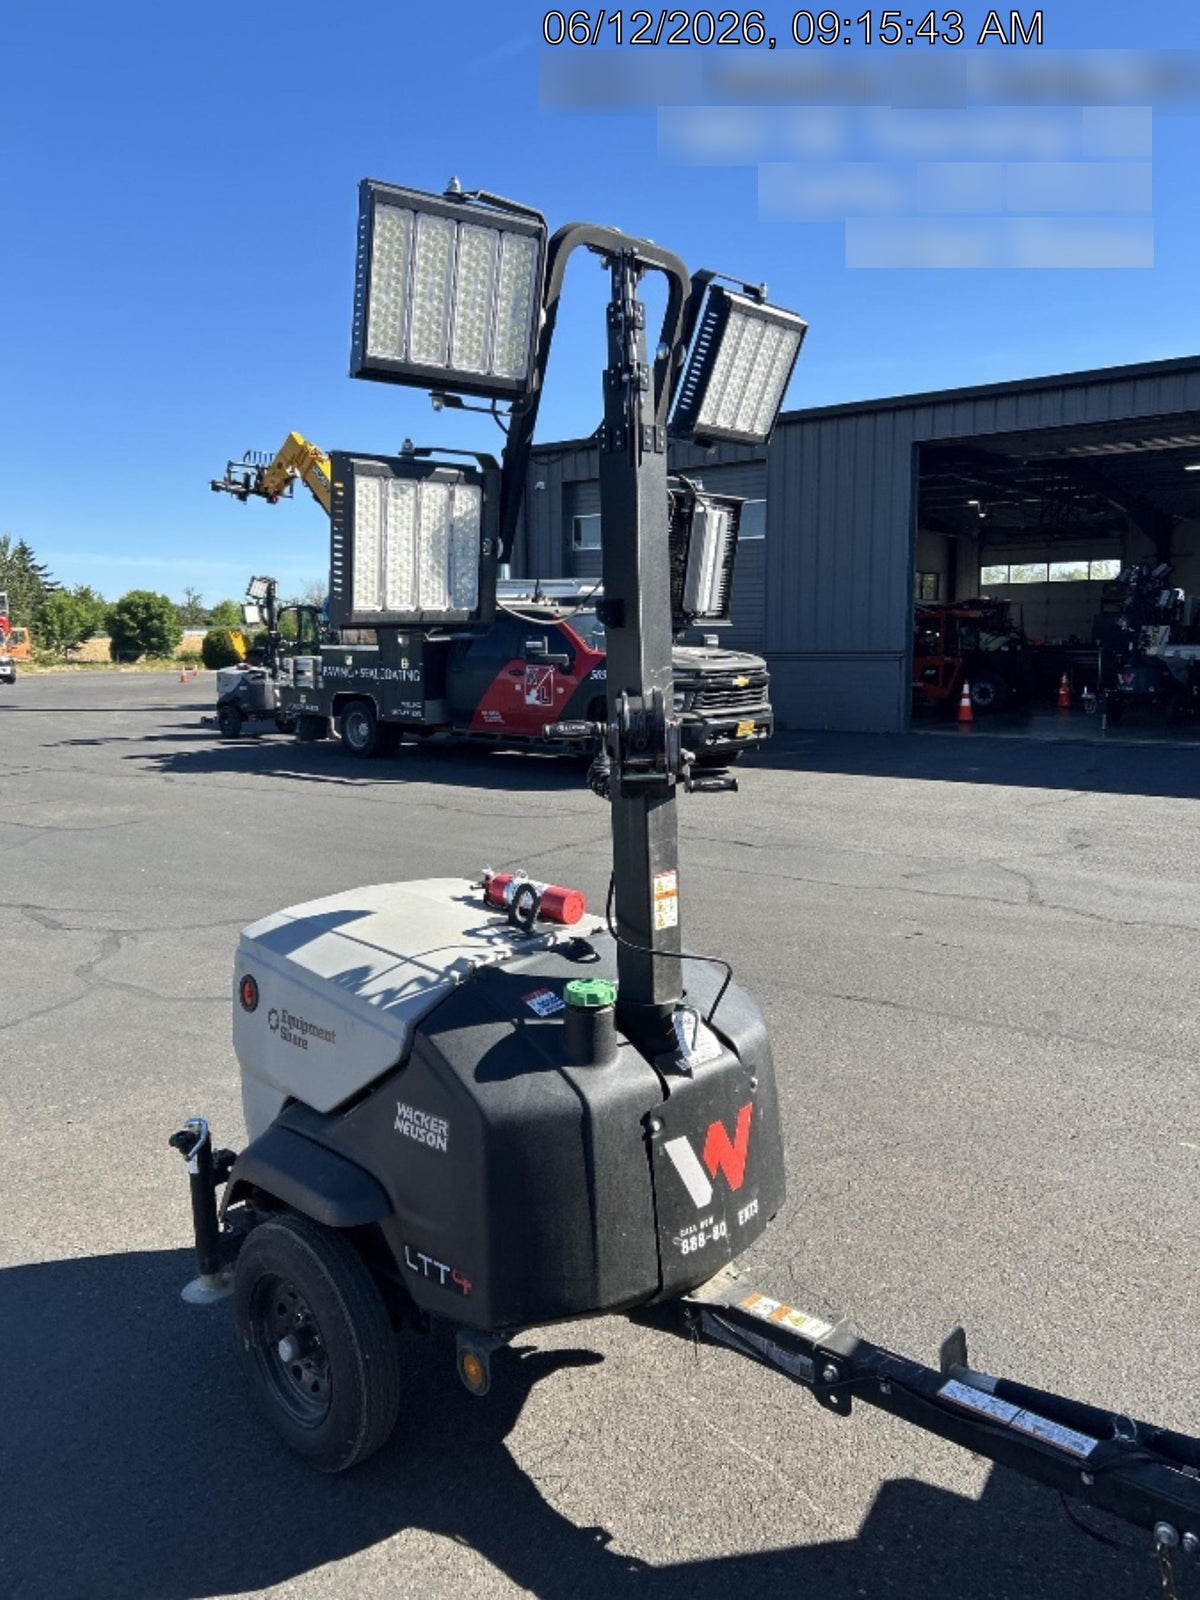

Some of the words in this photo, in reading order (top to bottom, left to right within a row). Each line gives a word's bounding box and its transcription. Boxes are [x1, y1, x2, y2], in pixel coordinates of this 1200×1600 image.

[280, 1025, 308, 1050] Share
[281, 1009, 336, 1044] Equipment
[394, 1115, 447, 1153] NEUSON
[397, 1101, 448, 1136] WACKER
